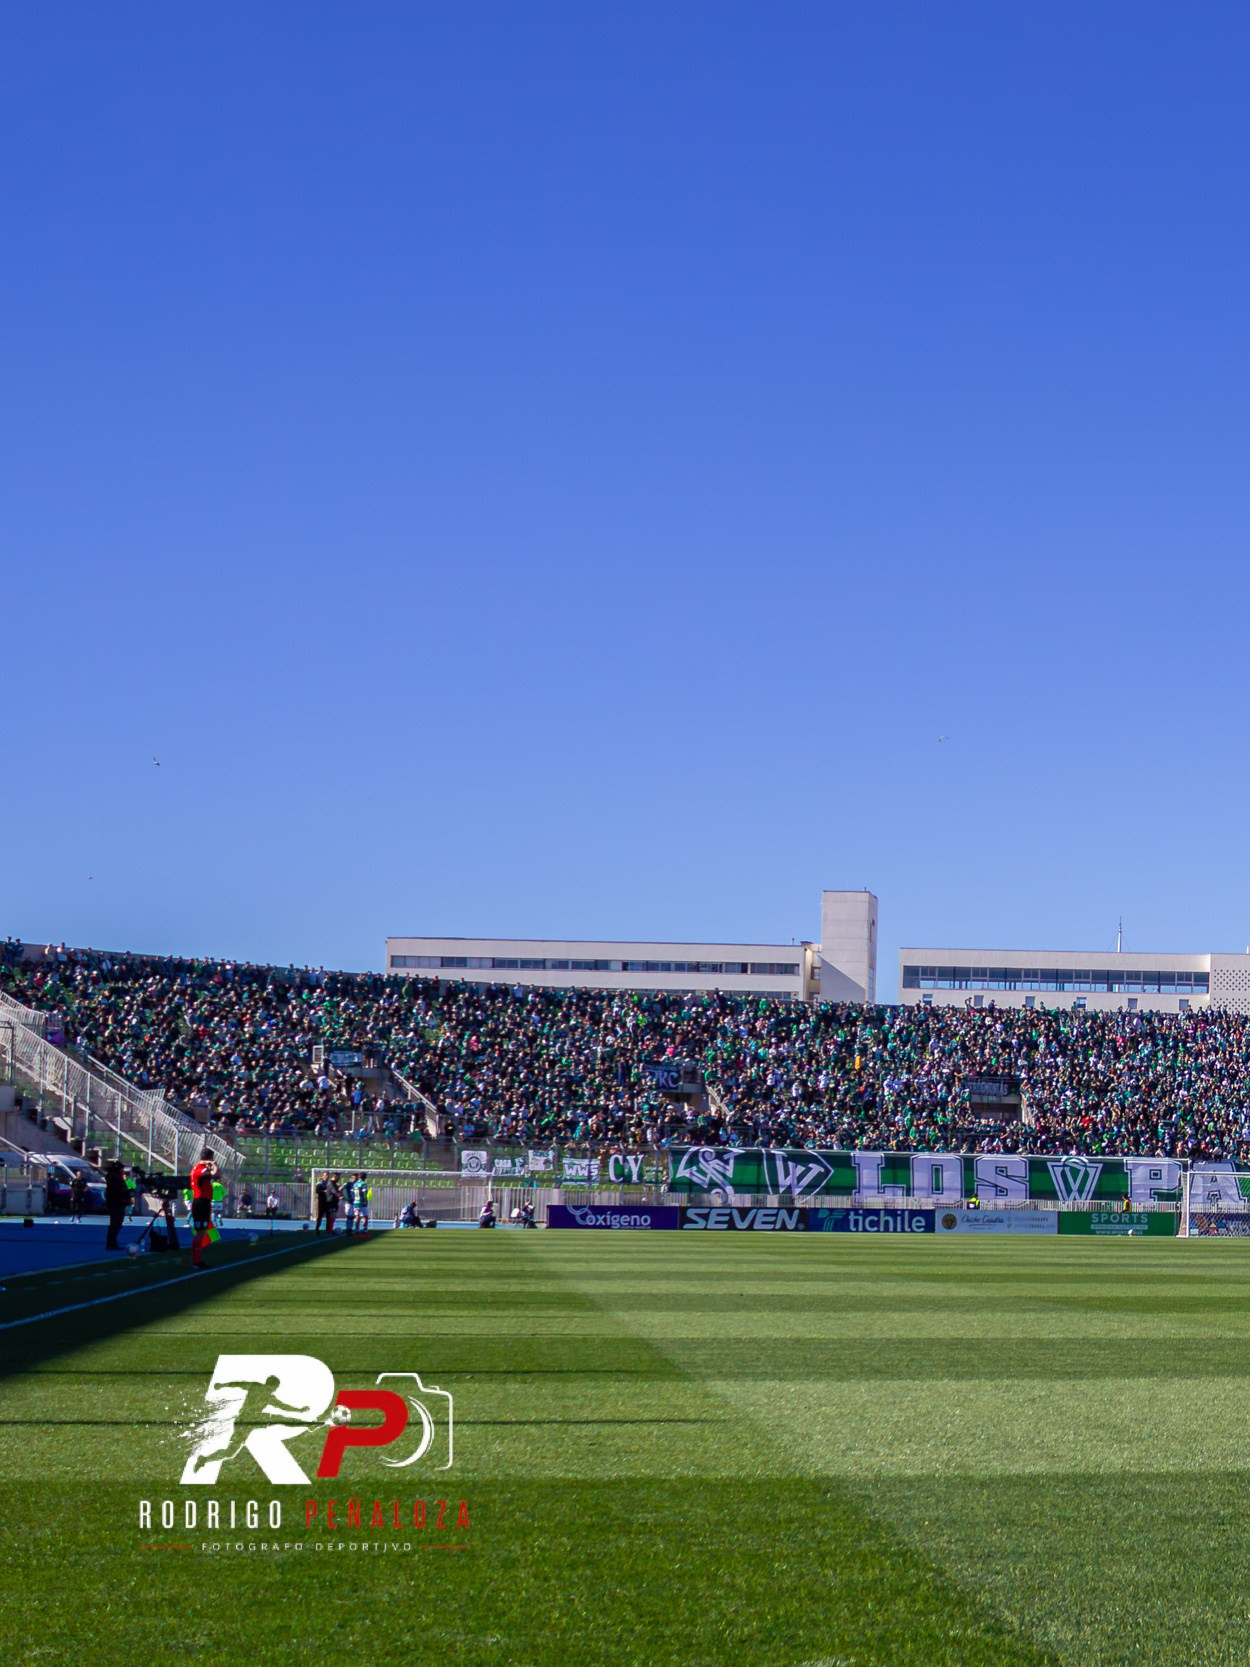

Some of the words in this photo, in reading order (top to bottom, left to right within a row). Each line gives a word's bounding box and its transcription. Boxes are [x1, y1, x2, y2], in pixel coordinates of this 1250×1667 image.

[608, 1154, 643, 1183] CY
[851, 1152, 1030, 1209] LOS
[585, 1211, 651, 1229] oxígeno
[683, 1208, 799, 1230] SEVEN
[1091, 1213, 1149, 1224] SPORTS
